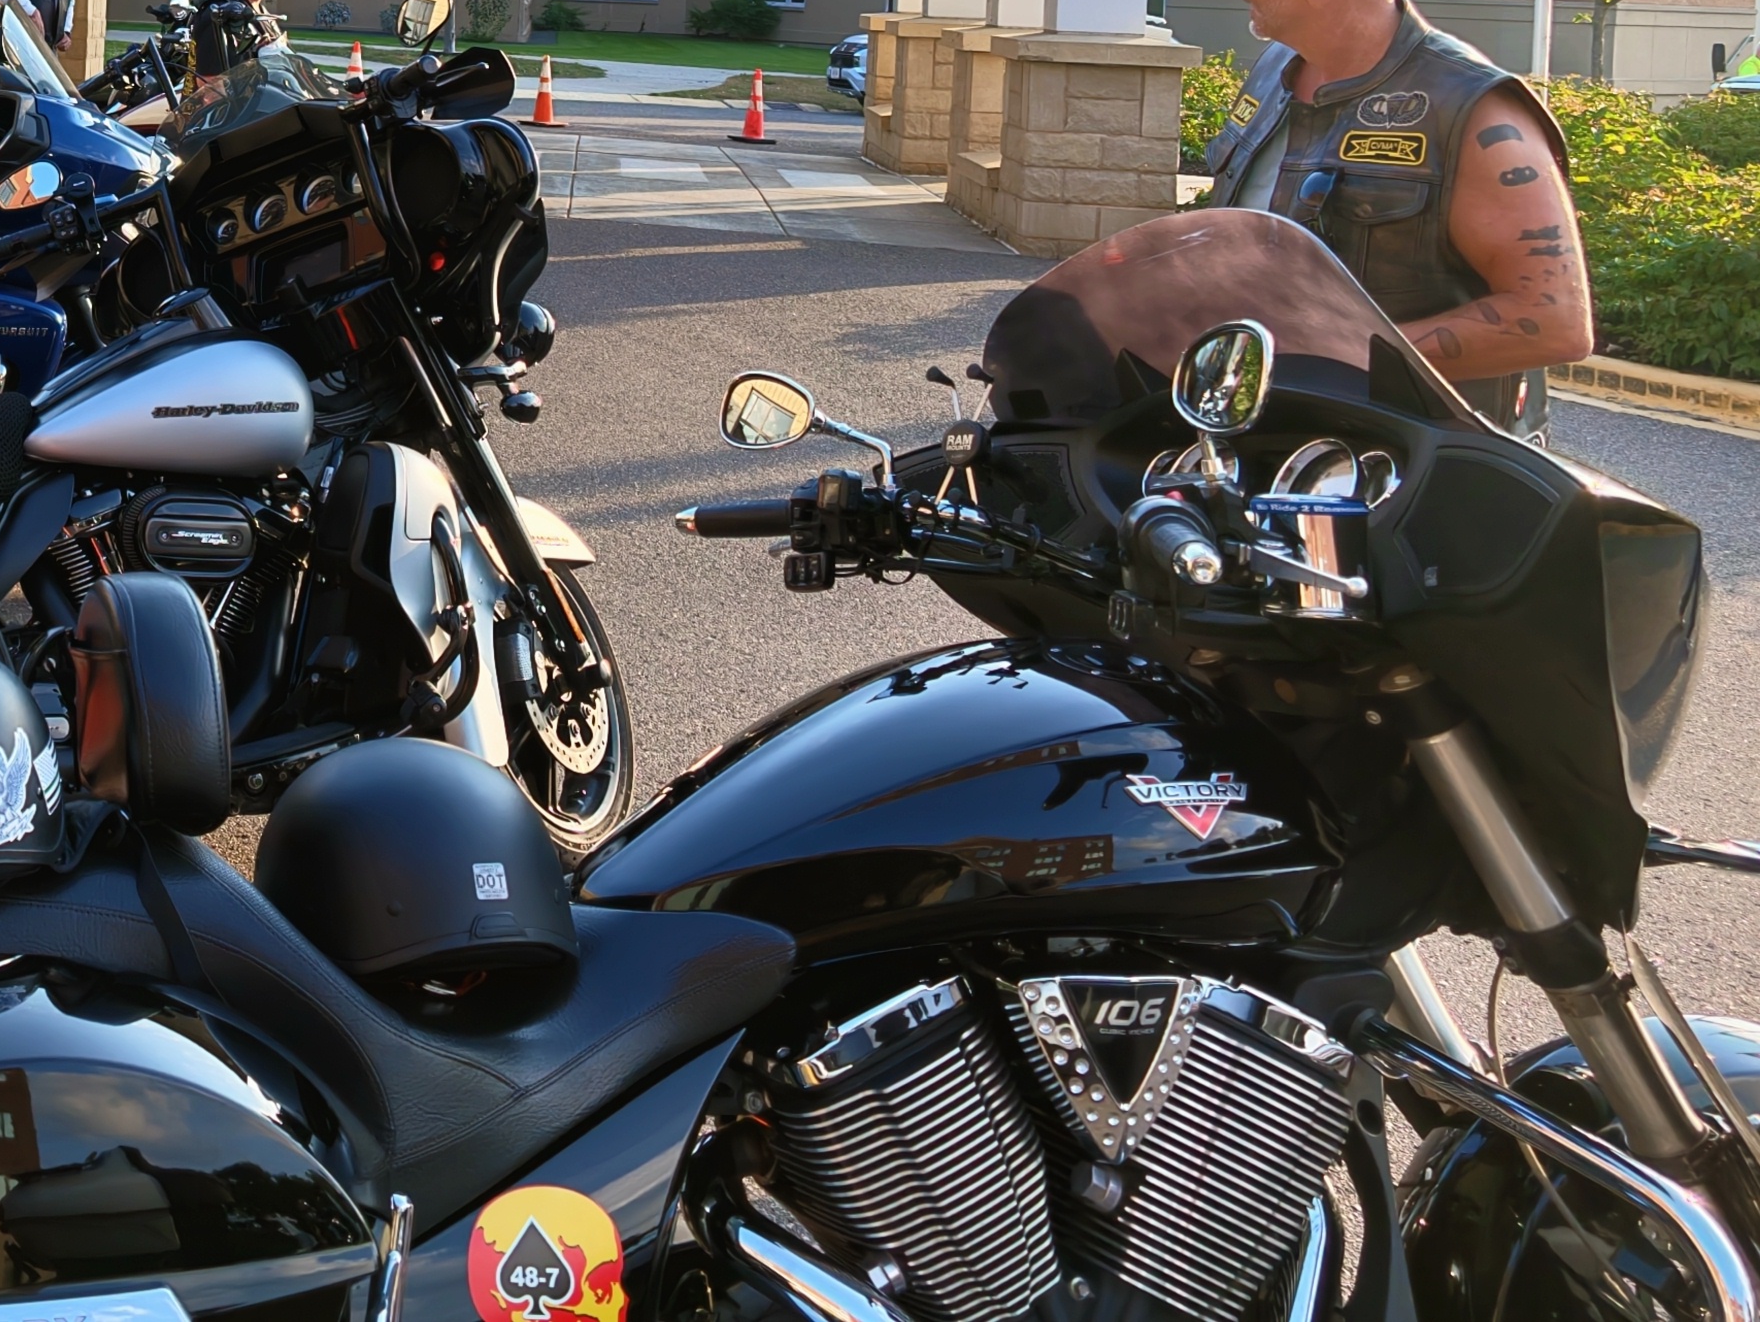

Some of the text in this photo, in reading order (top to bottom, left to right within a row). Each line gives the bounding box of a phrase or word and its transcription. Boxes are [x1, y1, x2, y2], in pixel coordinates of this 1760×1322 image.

[151, 401, 299, 418] Harley-Davidson
[946, 433, 975, 445] RAM
[1270, 504, 1298, 512] Ride
[1135, 783, 1243, 799] VICTORY
[475, 873, 503, 888] DOT
[1094, 997, 1166, 1026] 106
[510, 1266, 560, 1288] 48-7
